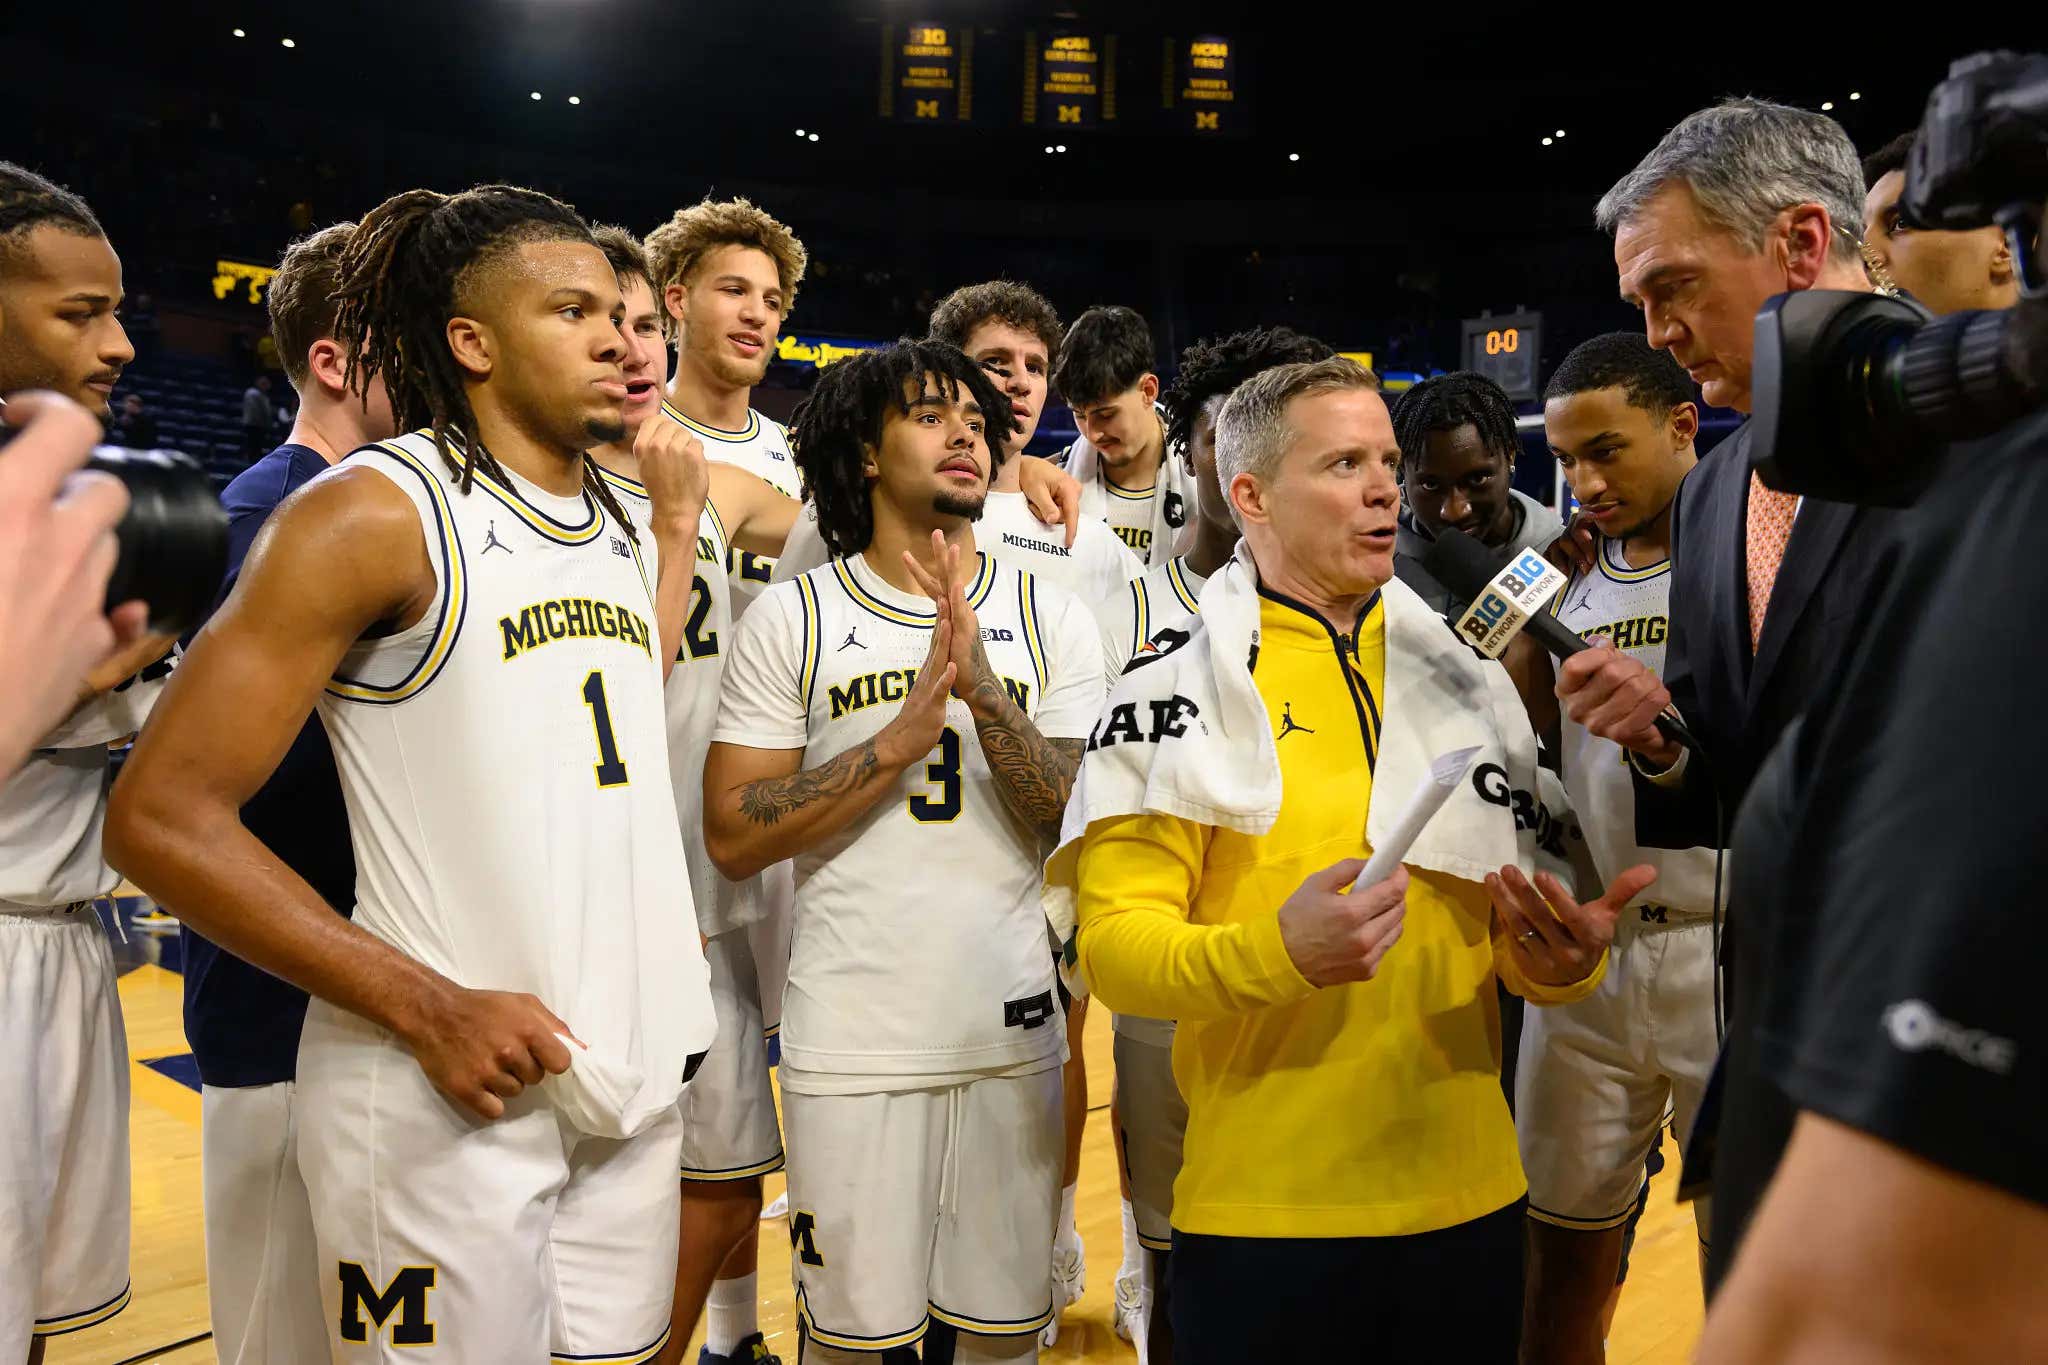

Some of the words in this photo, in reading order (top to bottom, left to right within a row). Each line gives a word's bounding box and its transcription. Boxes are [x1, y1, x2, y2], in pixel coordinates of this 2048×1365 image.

[915, 99, 939, 119] M
[1058, 104, 1082, 125] M
[1195, 111, 1219, 130] M
[1002, 532, 1070, 557] MICHIGAN
[1520, 572, 1558, 607] NETWORK
[498, 597, 654, 664] MICHIGAN
[1483, 610, 1521, 652] NETWORK
[580, 668, 630, 790] 1
[907, 724, 964, 825] 3
[1640, 904, 1668, 924] M
[336, 1258, 439, 1348] M
